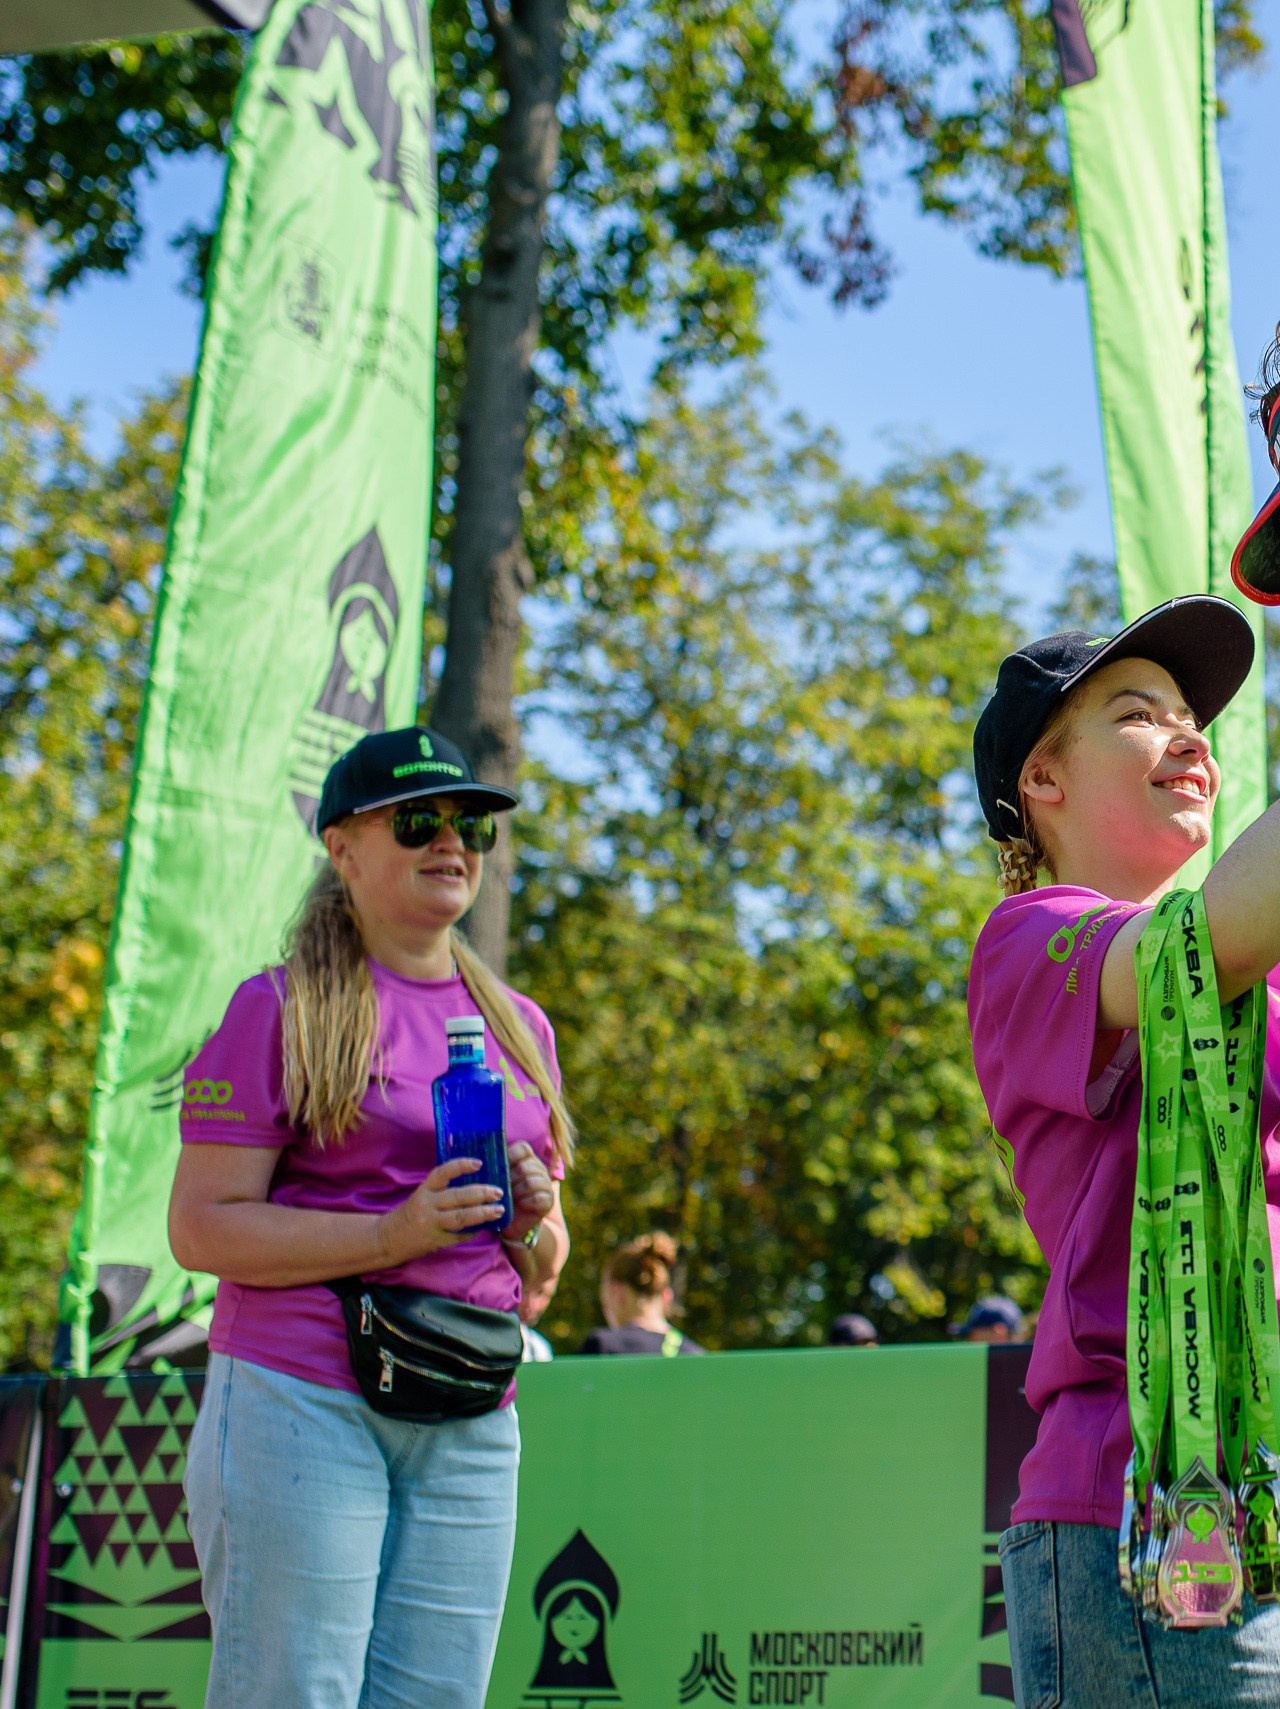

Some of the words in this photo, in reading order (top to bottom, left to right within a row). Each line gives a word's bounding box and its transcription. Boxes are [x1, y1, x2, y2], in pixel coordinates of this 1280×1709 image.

[1180, 1220, 1195, 1275] 113
[1138, 1248, 1150, 1402] МОСКВА
[1183, 1286, 1202, 1420] МОСКВА
[749, 1622, 924, 1667] МОСКОВСКИЙ
[749, 1670, 829, 1706] СПОРТ
